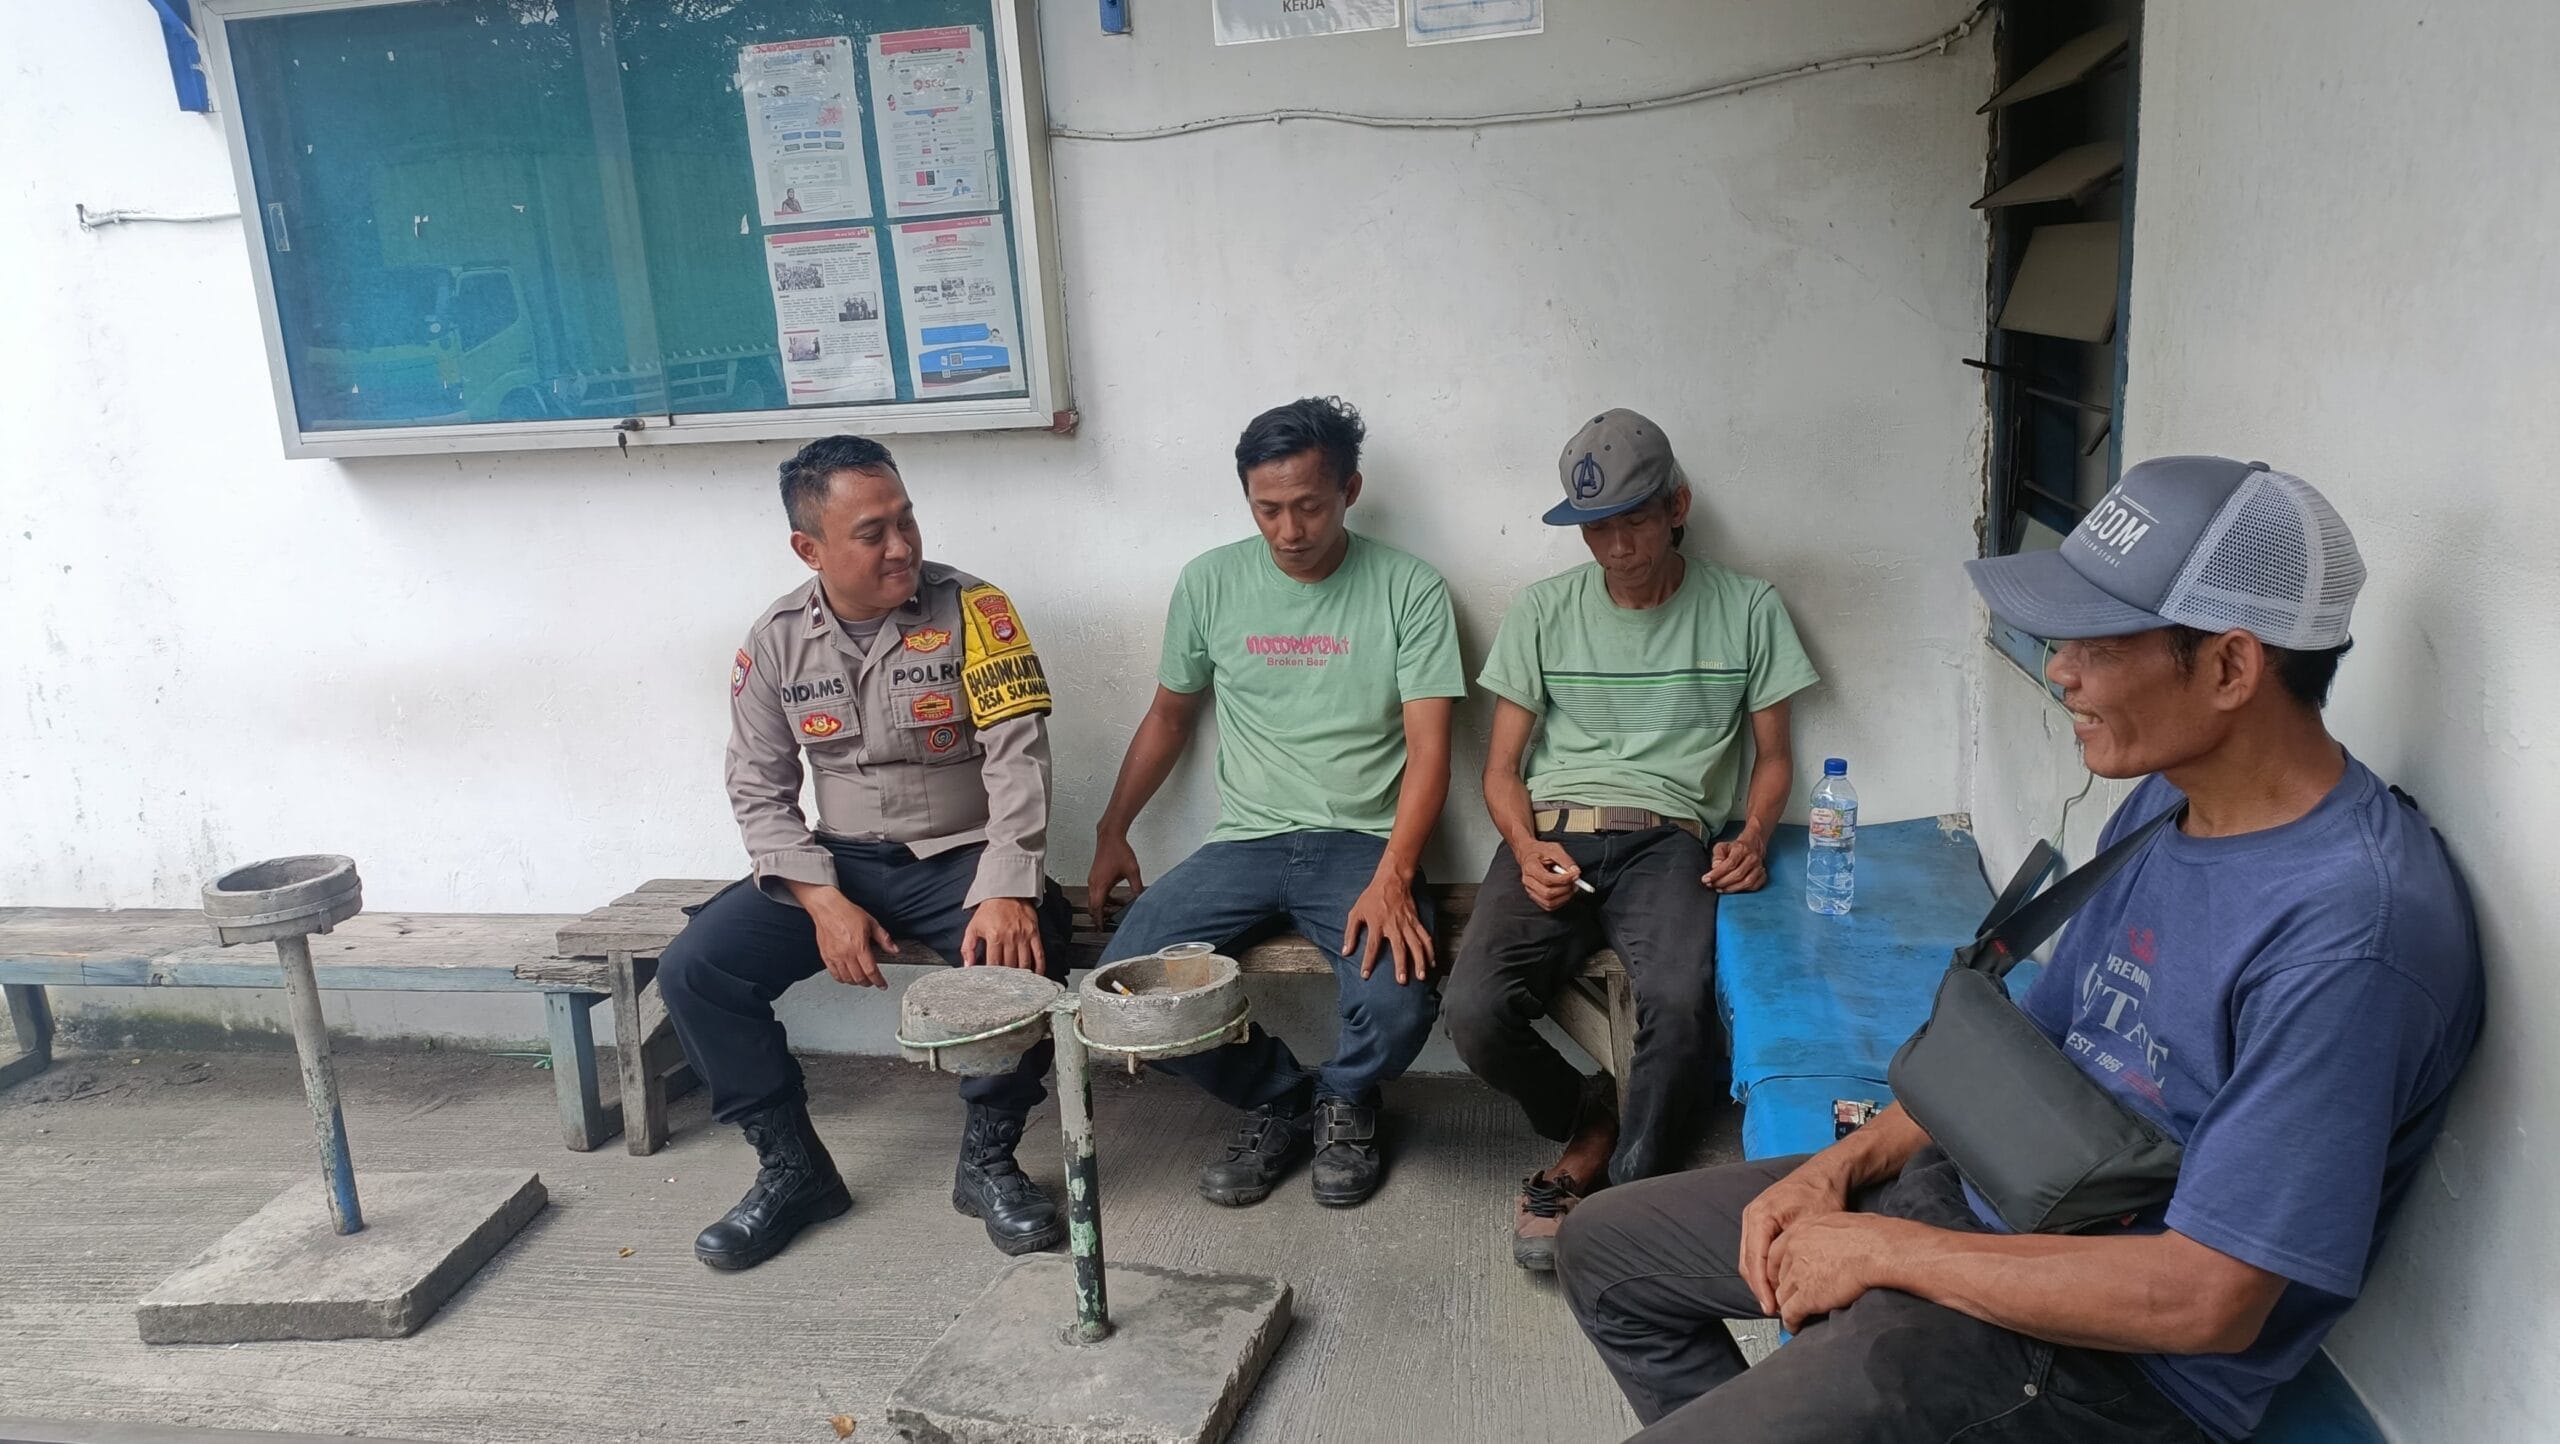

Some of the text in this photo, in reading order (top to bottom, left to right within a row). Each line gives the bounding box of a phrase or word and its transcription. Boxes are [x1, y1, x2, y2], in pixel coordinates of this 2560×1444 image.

[1283, 0, 1325, 12] KERJA
[1266, 657, 1328, 666] Broken Bear
[893, 661, 961, 685] POLRI
[977, 690, 1005, 712] DESA
[2066, 1032, 2096, 1057] EST.
